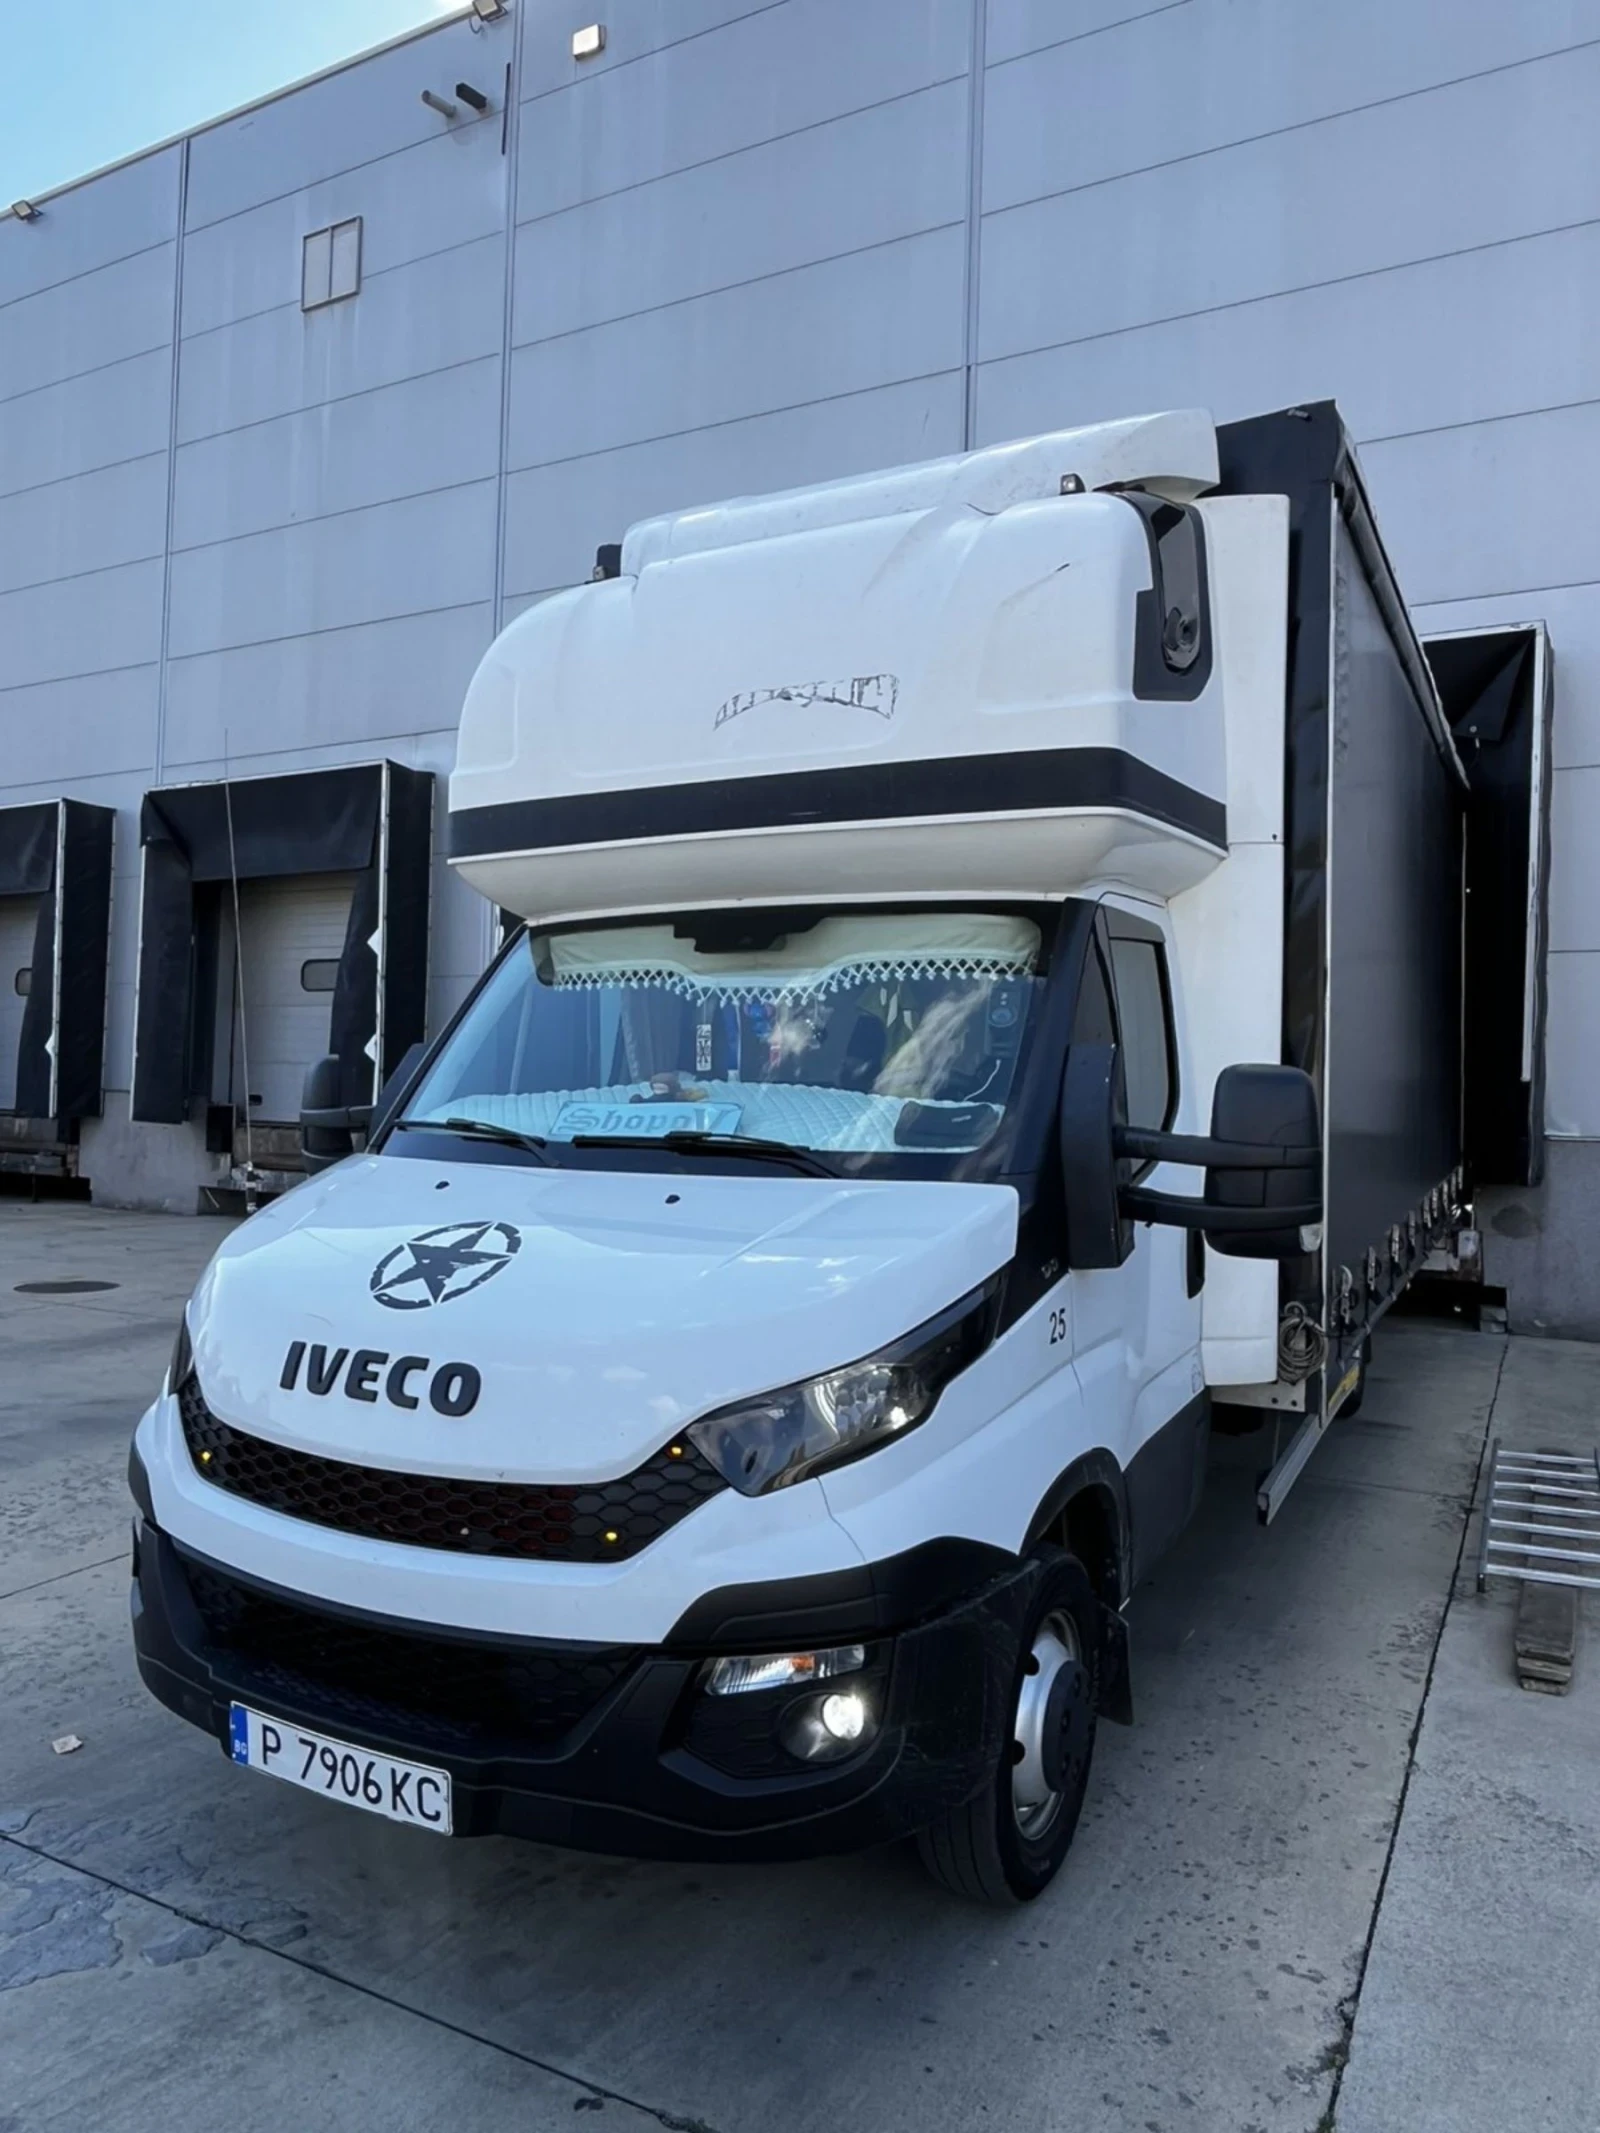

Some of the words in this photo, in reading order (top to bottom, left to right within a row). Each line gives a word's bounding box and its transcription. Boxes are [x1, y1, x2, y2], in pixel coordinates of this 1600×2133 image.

[1049, 1307, 1067, 1345] 25
[279, 1340, 482, 1417] IVECO
[234, 1739, 248, 1755] BG
[262, 1723, 281, 1765] P
[298, 1736, 383, 1805] 7906
[391, 1767, 442, 1822] KC
